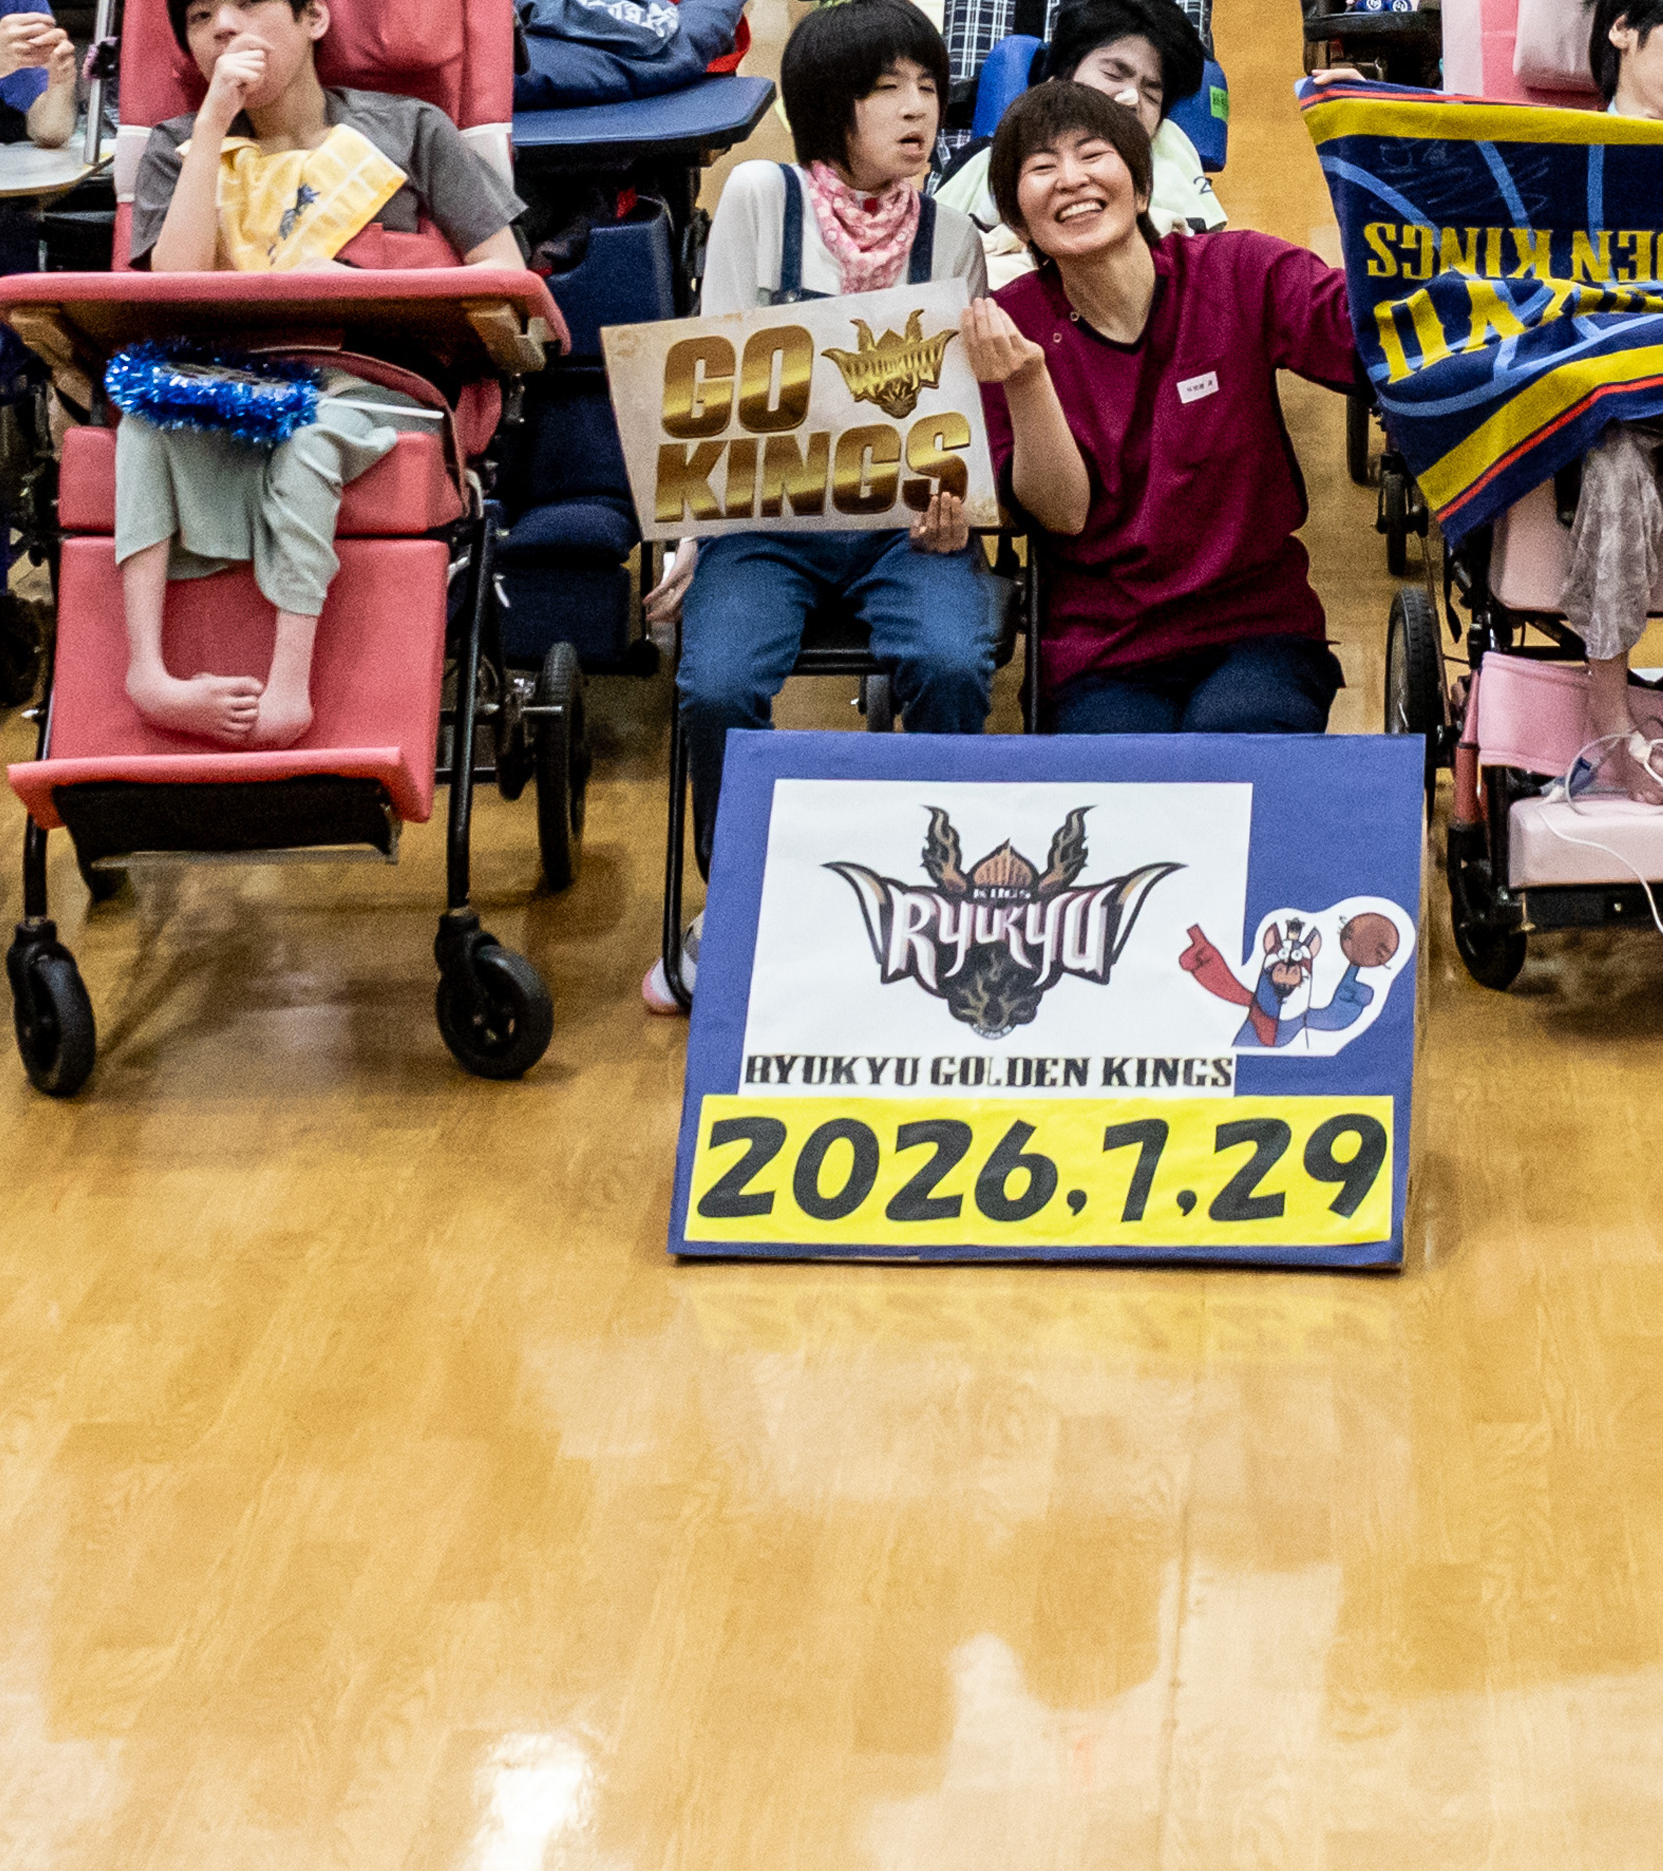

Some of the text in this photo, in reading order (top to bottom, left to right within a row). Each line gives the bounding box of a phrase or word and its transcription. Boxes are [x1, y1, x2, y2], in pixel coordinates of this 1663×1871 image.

[1364, 221, 1554, 281] KINGS
[661, 324, 814, 440] GO
[654, 412, 971, 523] KINGS
[745, 1055, 1234, 1088] RYUKYU GOLDEN KINGS
